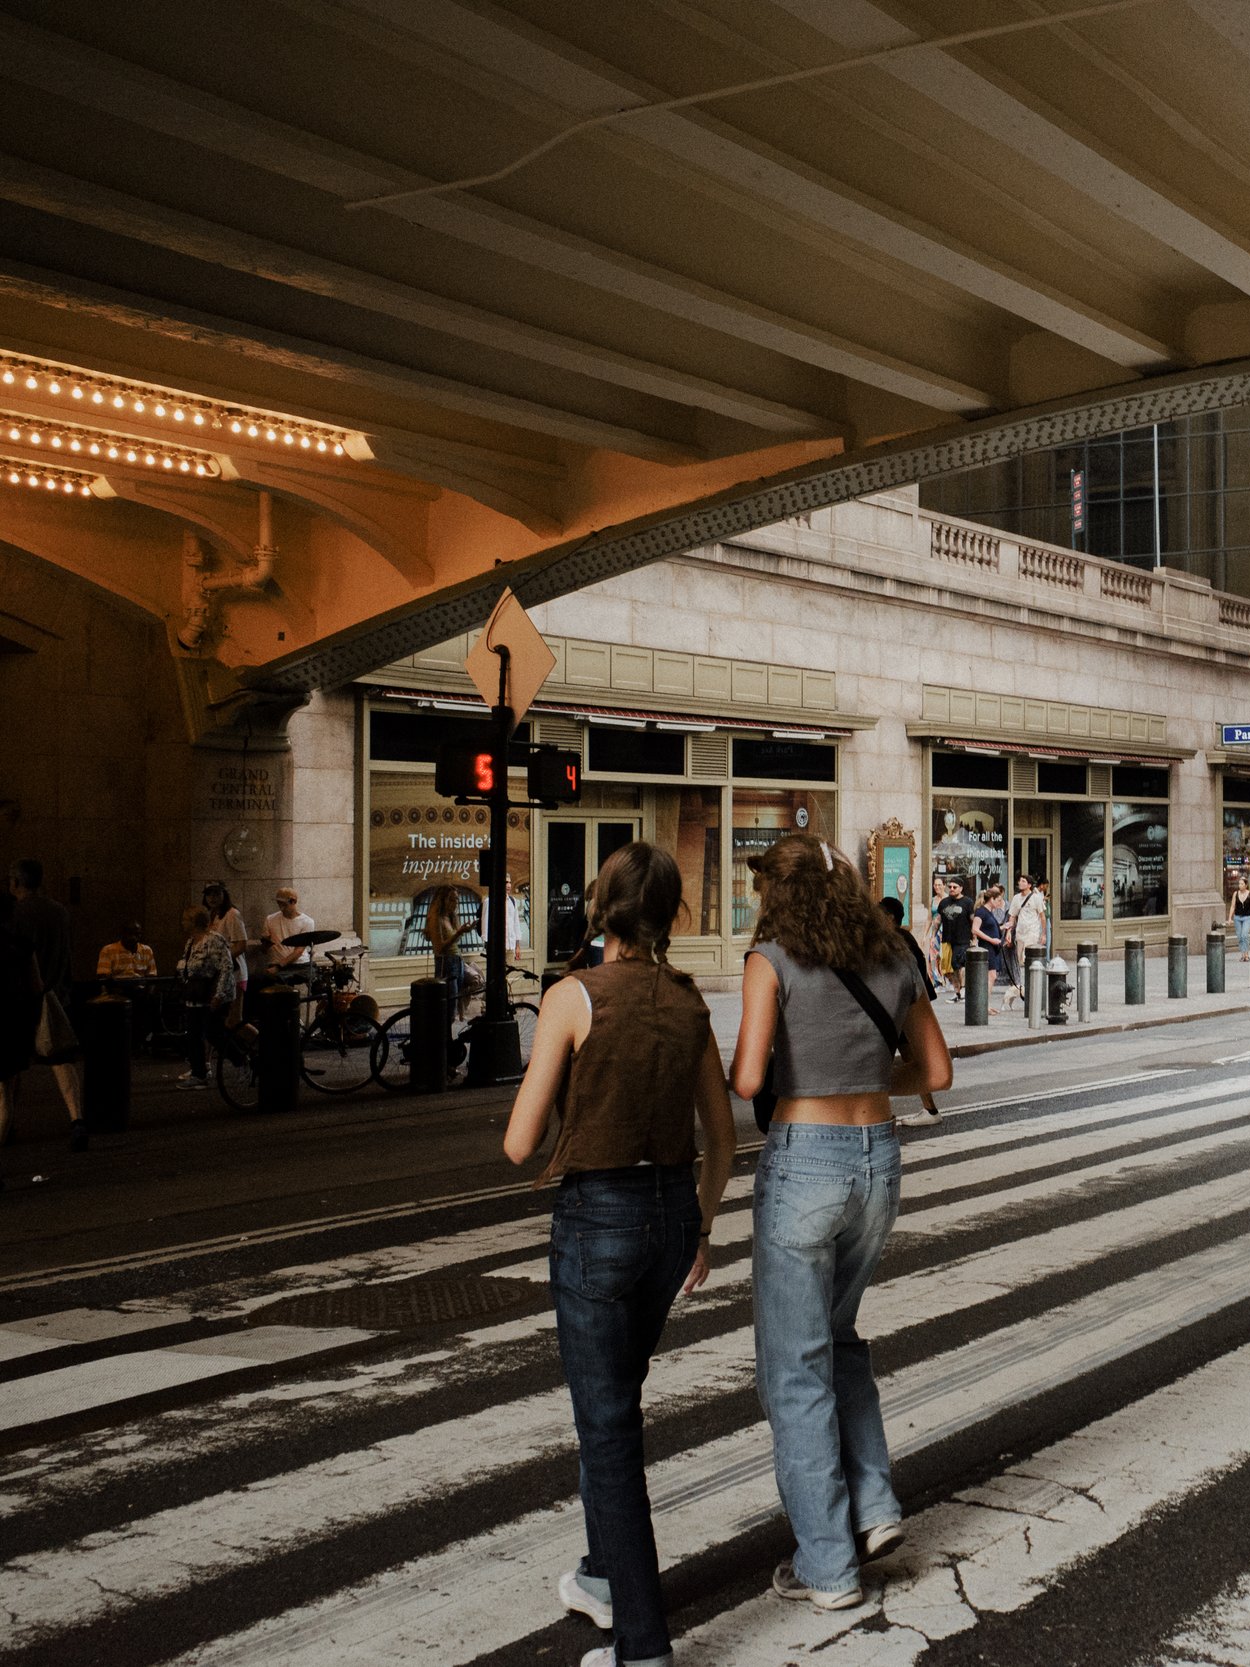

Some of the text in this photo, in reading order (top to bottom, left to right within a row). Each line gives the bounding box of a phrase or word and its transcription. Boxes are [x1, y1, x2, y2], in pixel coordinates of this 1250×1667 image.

[219, 768, 269, 780] GRAND
[475, 753, 493, 791] 5
[566, 765, 577, 791] 4
[212, 783, 274, 795] CENTRAL
[209, 797, 278, 810] TERMINAL
[408, 833, 436, 848] The
[968, 831, 1003, 842] For all the
[966, 849, 1004, 859] things that
[402, 855, 472, 880] inspiring
